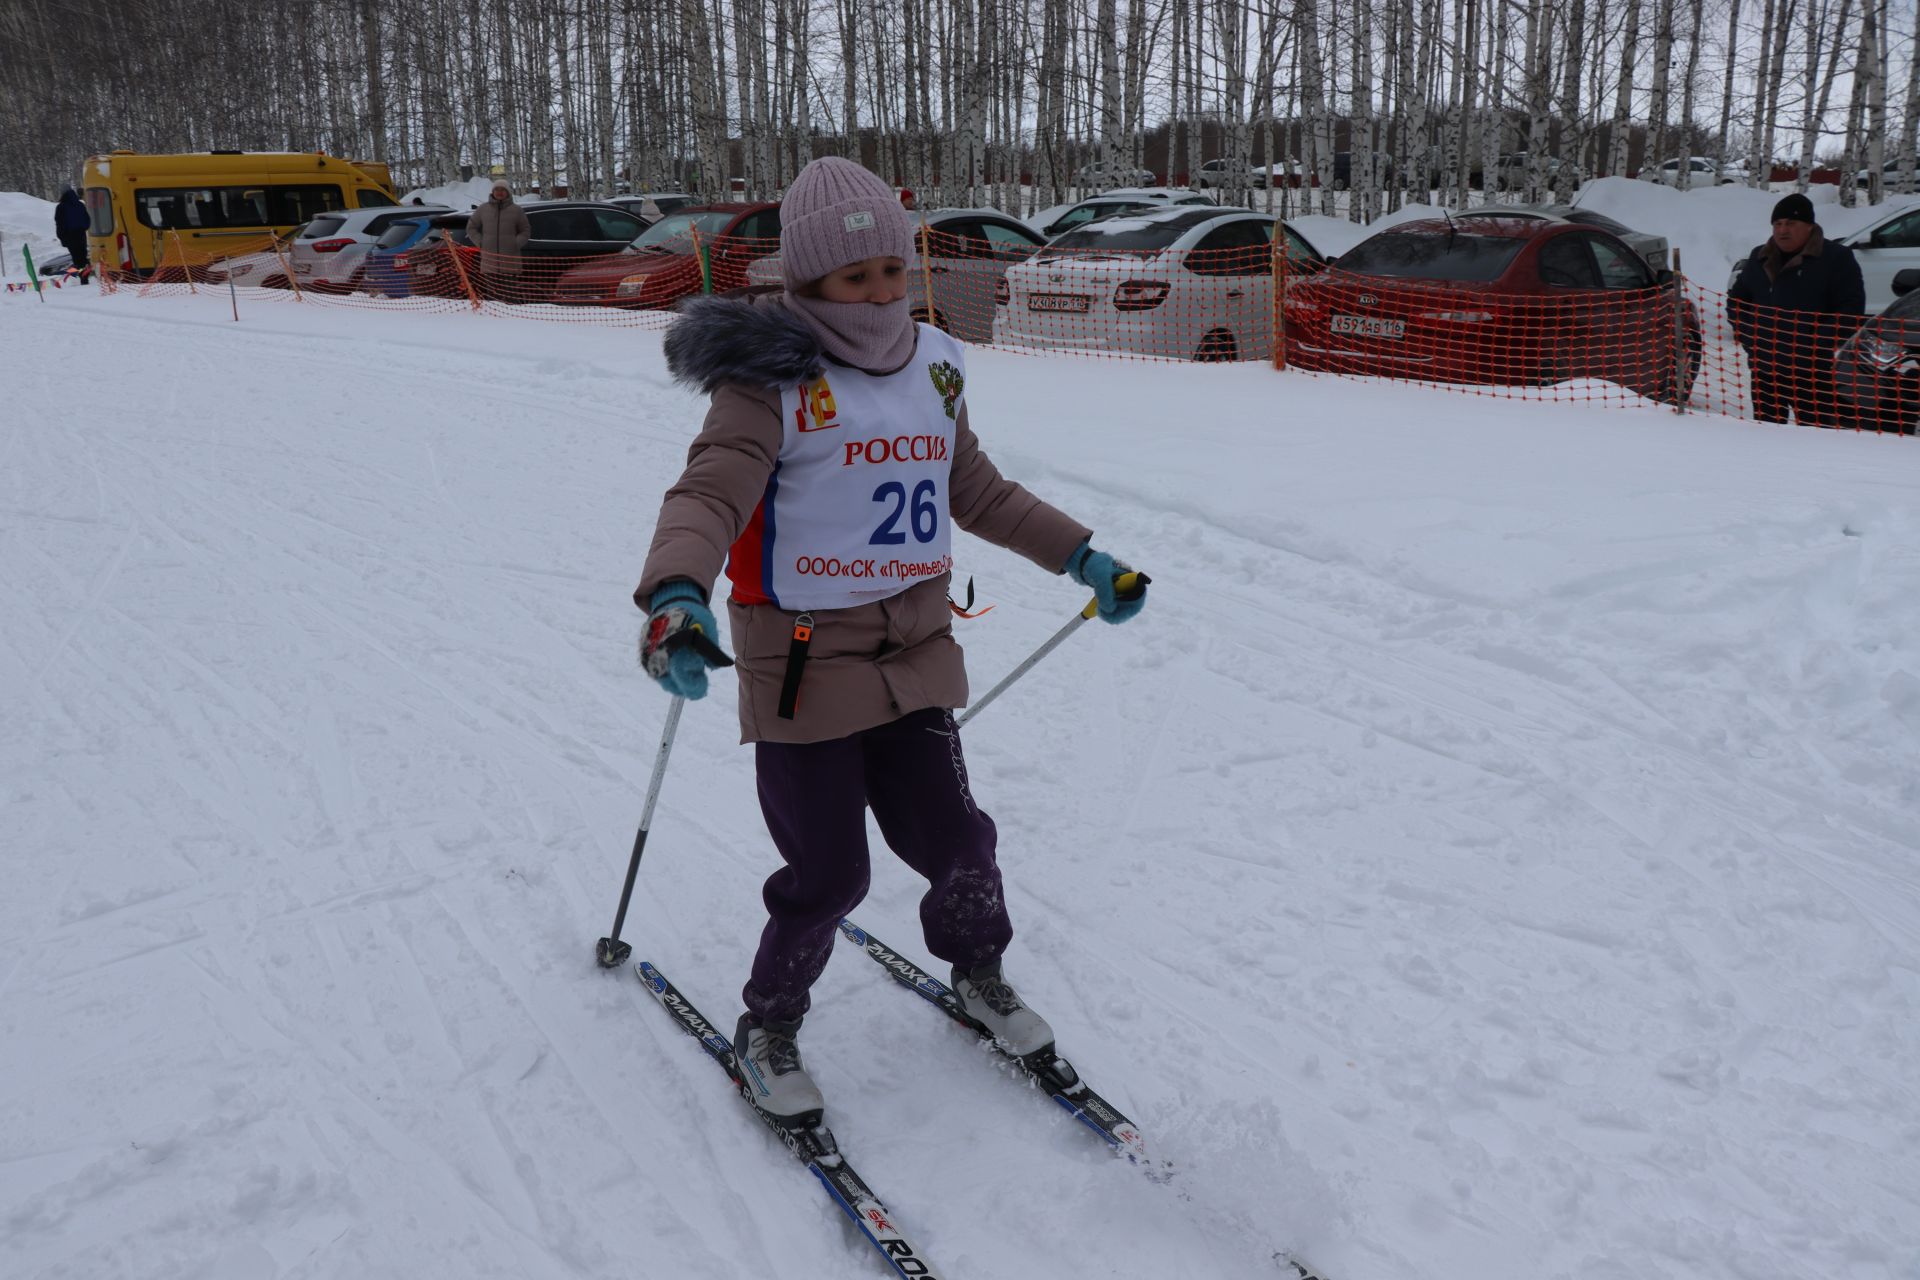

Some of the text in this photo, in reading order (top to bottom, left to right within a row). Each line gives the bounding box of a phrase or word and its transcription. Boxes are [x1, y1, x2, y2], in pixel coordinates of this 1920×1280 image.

[843, 435, 948, 466] РОССИЯ
[868, 479, 937, 545] 26
[866, 1208, 898, 1235] SK
